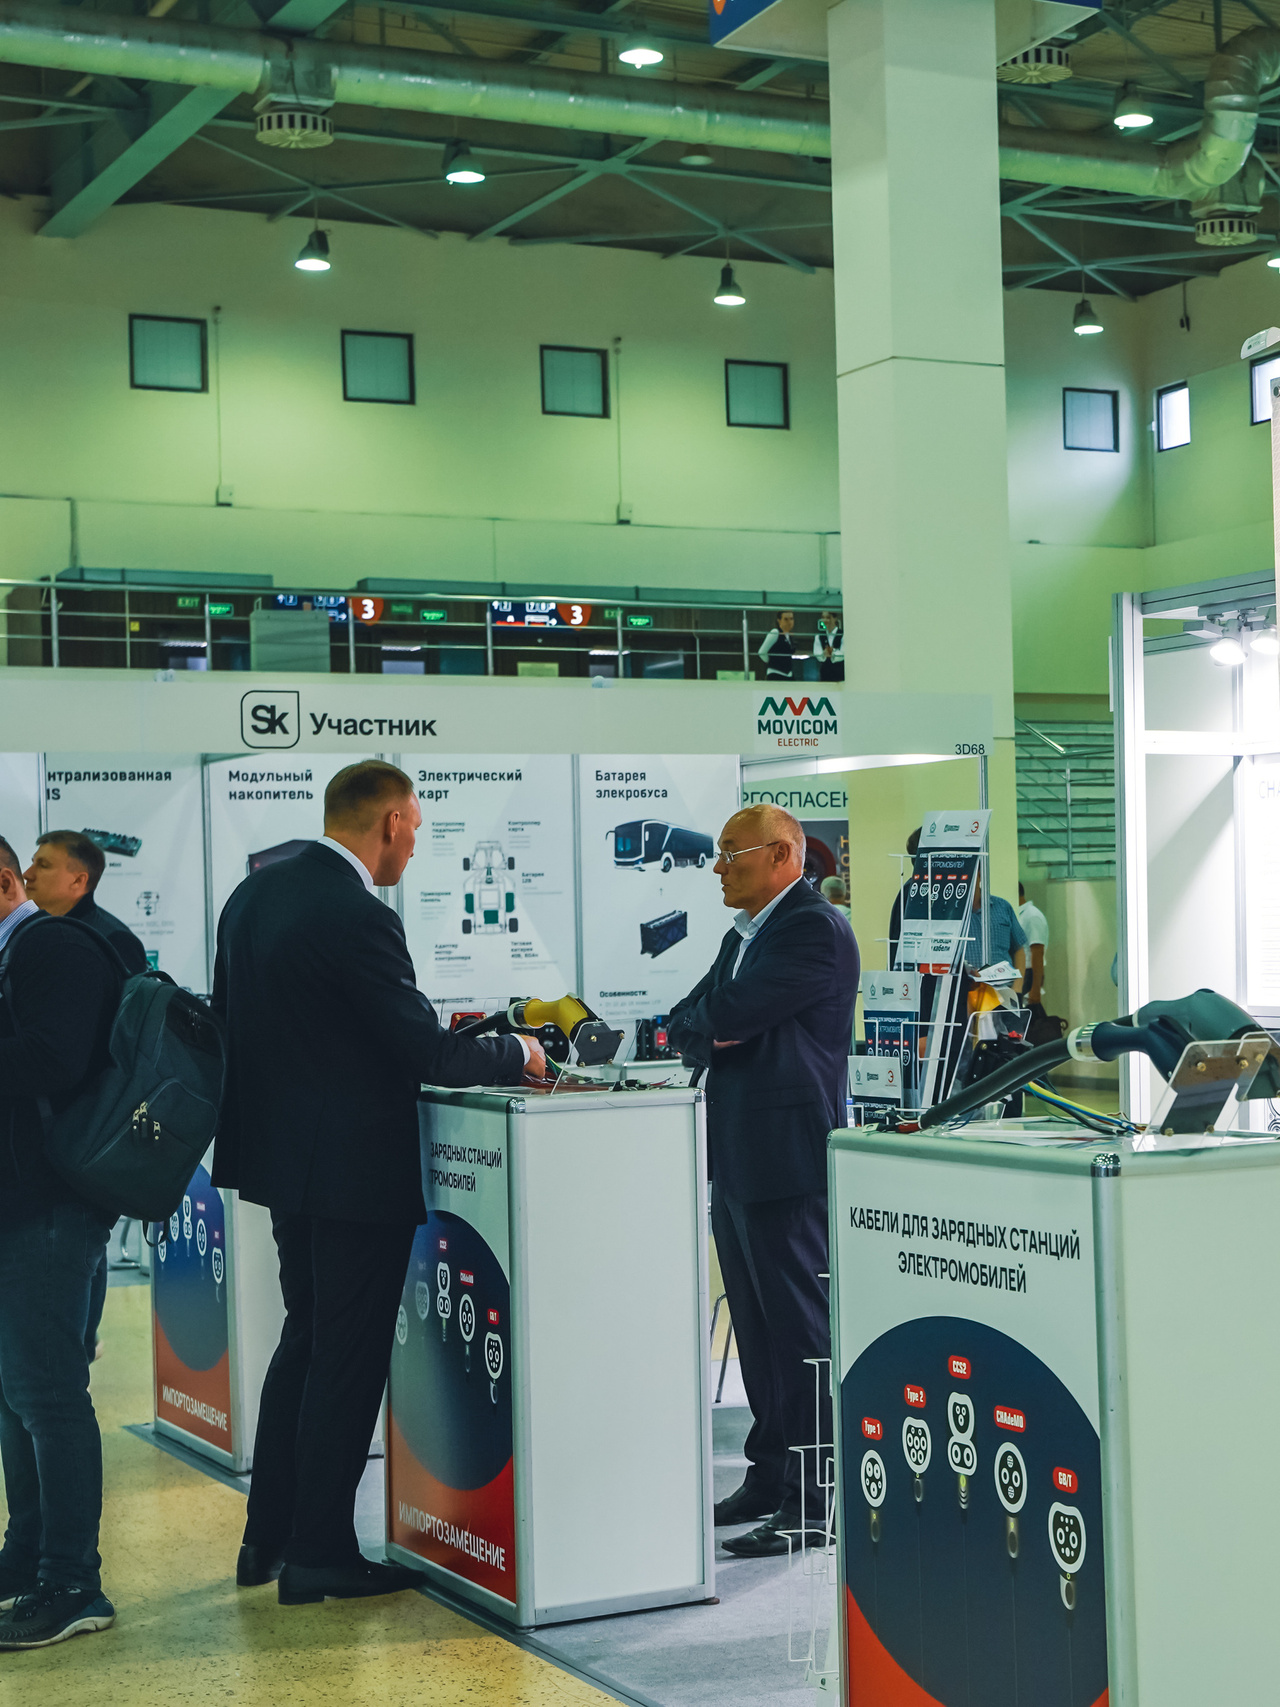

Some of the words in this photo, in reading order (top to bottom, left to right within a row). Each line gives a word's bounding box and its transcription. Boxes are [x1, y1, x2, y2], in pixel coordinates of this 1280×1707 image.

[361, 599, 375, 620] 3
[570, 605, 583, 625] 3
[250, 704, 289, 735] Sk
[309, 711, 438, 738] Участник
[757, 719, 838, 735] MOVICOM
[777, 738, 819, 747] ELECTRIC
[954, 743, 985, 755] 3D68
[47, 770, 172, 784] нтрализованная
[228, 769, 313, 783] Модульный
[418, 769, 522, 784] Электрический
[595, 769, 646, 783] Батарея
[228, 788, 313, 800] накопитель
[418, 789, 449, 802] карт
[595, 788, 668, 801] элекробуса
[430, 1142, 467, 1164] ЗАРЯДНЫХ
[467, 1147, 503, 1170] СТАНЦИЙ
[430, 1169, 476, 1193] ТРОМОБИЛЕЙ
[850, 1206, 899, 1234] КАБЕЛИ
[901, 1213, 929, 1239] ДЛЯ
[931, 1217, 1008, 1250] ЗАРЯДНЫХ
[1009, 1227, 1081, 1261] СТАНЦИЙ
[898, 1251, 1027, 1294] ЭЛЕКТРОМОБИЛЕЙ
[952, 1360, 967, 1375] CCS2
[906, 1387, 919, 1403] Type
[919, 1390, 924, 1403] 2
[162, 1384, 228, 1432] ИМПОРТОЗАМЕЩЕНИЕ
[864, 1420, 876, 1435] Type
[996, 1410, 1024, 1429] CHAdeMO
[1058, 1471, 1073, 1488] GB/T
[398, 1500, 506, 1572] ИМПОРТОЗАМЕЩЕНИЕ
